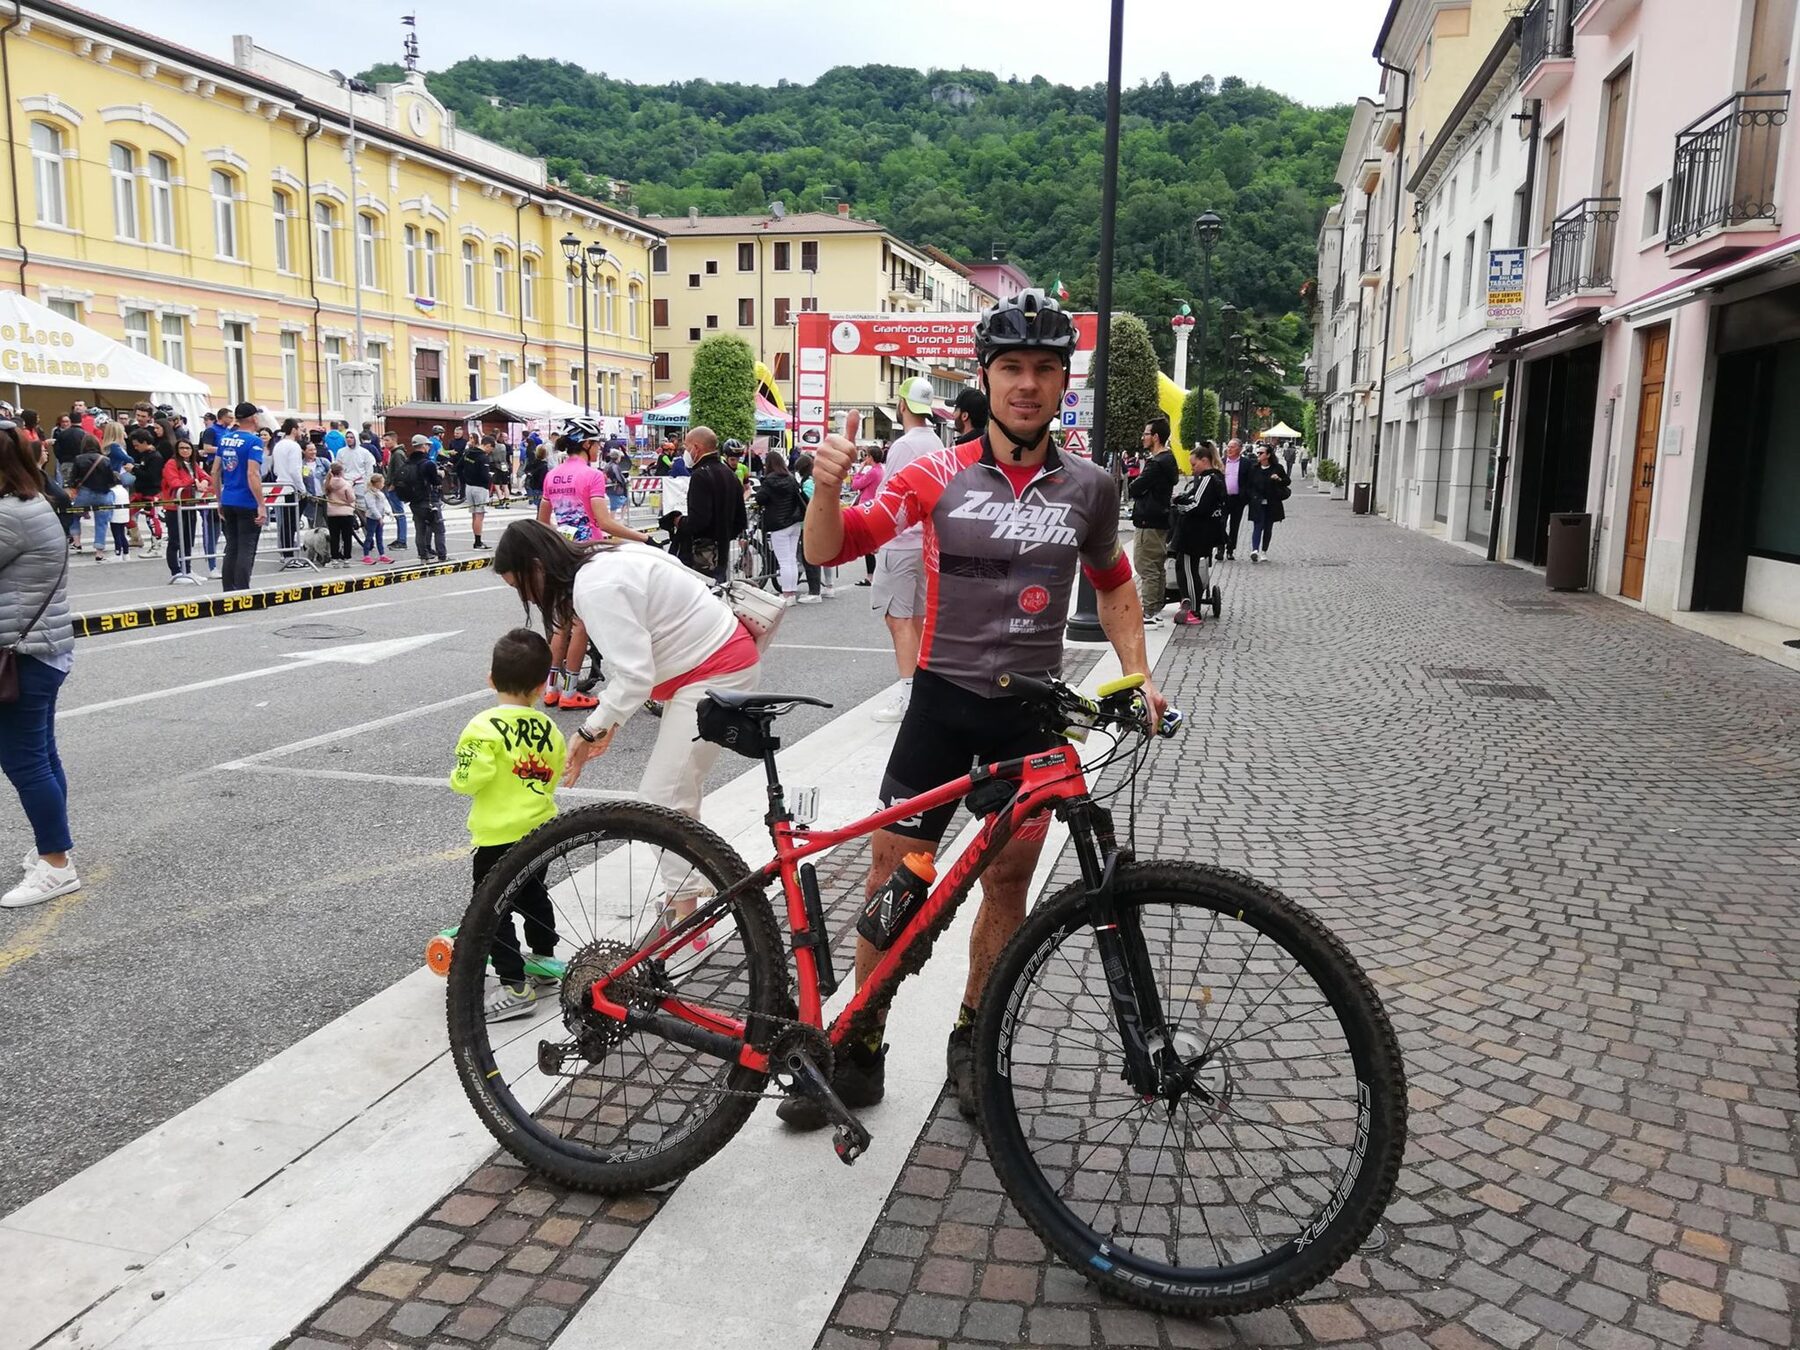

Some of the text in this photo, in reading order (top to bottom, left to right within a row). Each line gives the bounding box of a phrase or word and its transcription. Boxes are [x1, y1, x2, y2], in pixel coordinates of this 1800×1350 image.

[873, 325, 929, 333] Granfondo
[958, 325, 969, 333] di
[908, 335, 976, 344] Durona Bik
[2, 349, 109, 382] Chiampo
[220, 437, 245, 448] STAFF
[996, 924, 1069, 1078] CROSSMAX
[1294, 1080, 1371, 1253] CROSSMAX
[1113, 1267, 1270, 1298] SCHWALBE
